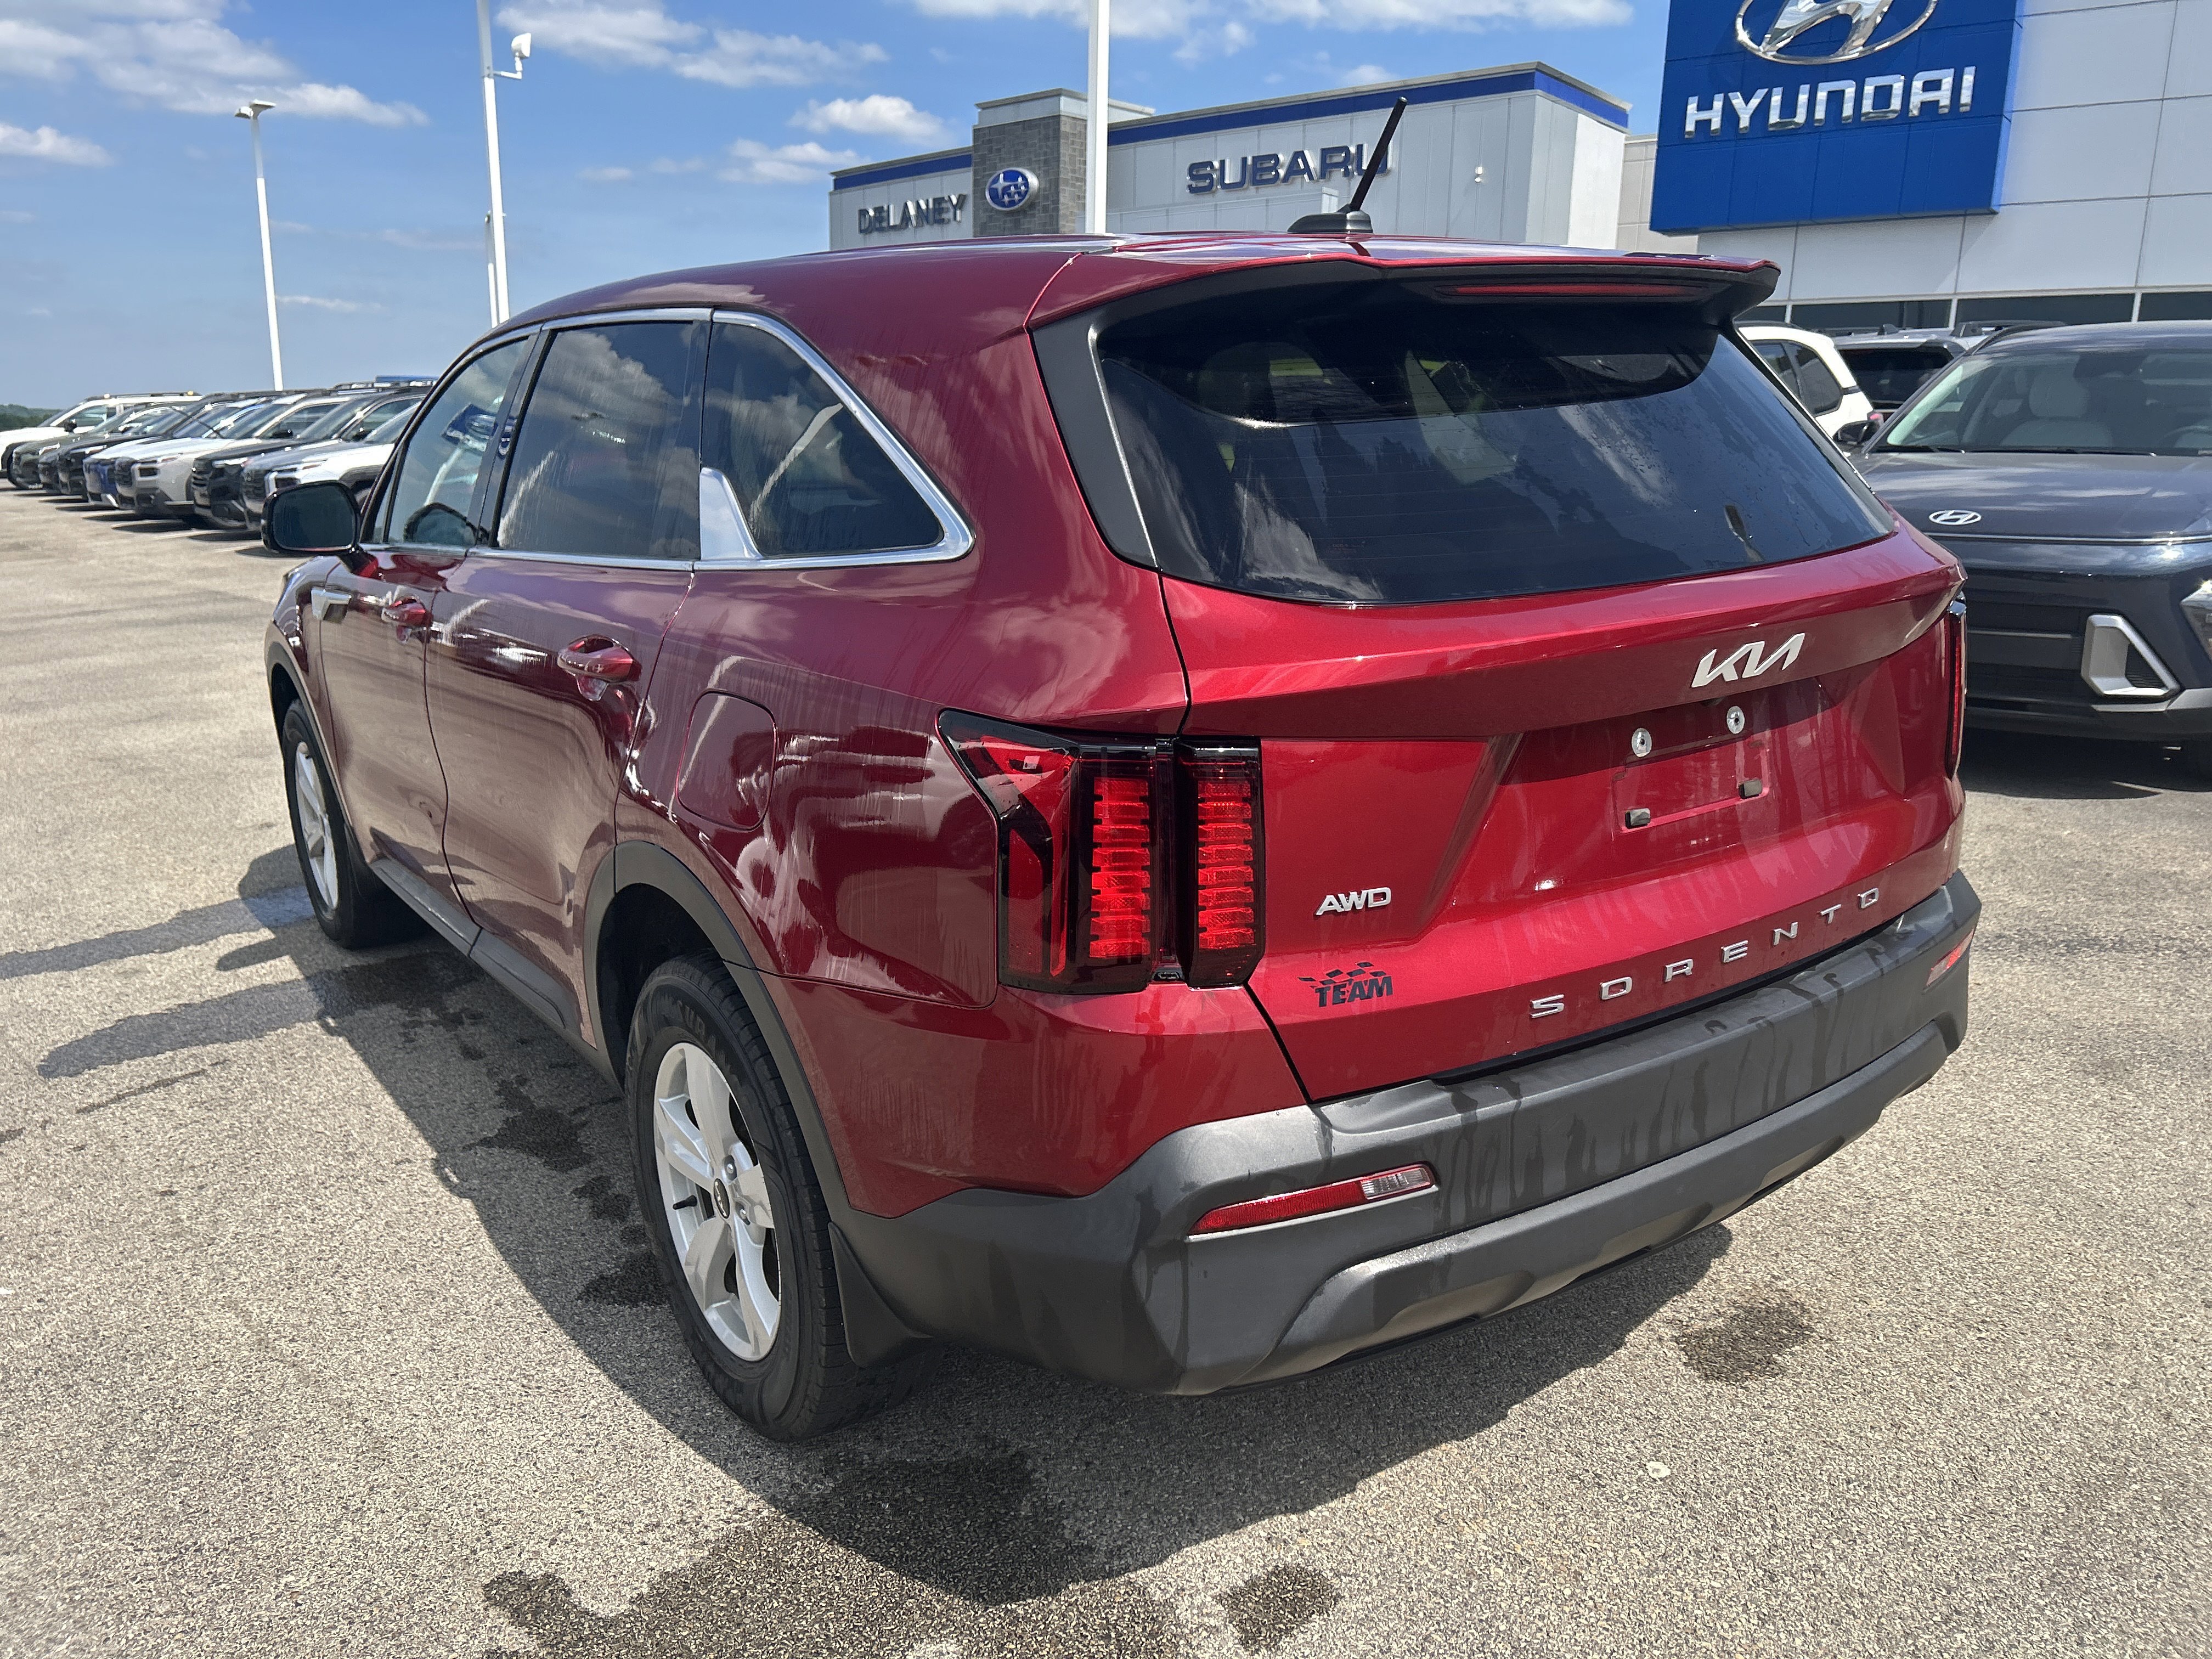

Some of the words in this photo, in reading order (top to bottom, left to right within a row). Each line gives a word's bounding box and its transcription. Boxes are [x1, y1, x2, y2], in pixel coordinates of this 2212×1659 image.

[1684, 66, 1976, 138] HYUNDAI
[1187, 143, 1390, 194] SUBARU
[858, 194, 967, 234] DELANEY
[1316, 887, 1392, 916] AWD
[1530, 887, 1880, 1019] SORENTO
[1314, 975, 1393, 1007] TEAM
